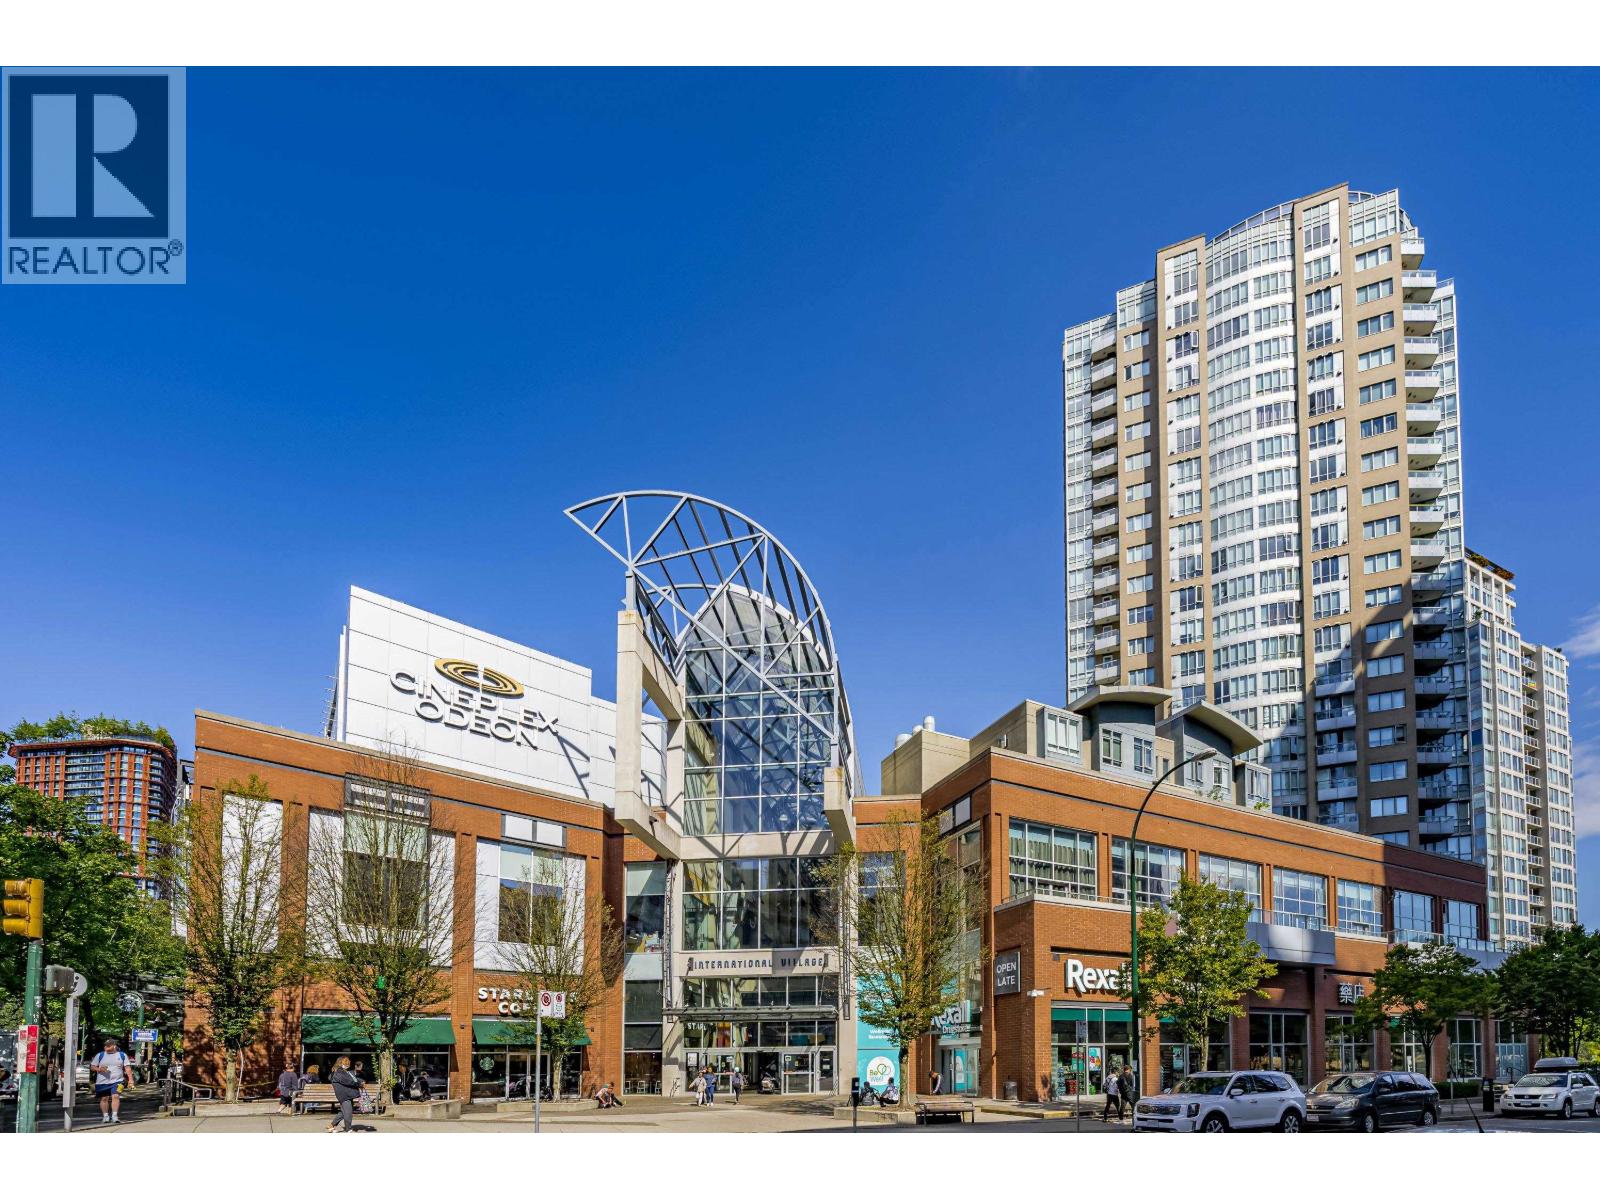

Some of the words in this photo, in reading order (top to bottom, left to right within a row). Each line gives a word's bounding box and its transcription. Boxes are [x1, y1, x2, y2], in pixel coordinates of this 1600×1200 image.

[390, 671, 558, 733] CINEPLEX
[415, 699, 538, 750] ODEON
[694, 959, 773, 970] INTERNATIONAL
[781, 957, 823, 968] VILLAGE
[996, 961, 1017, 974] OPEN
[997, 975, 1016, 987] LATE
